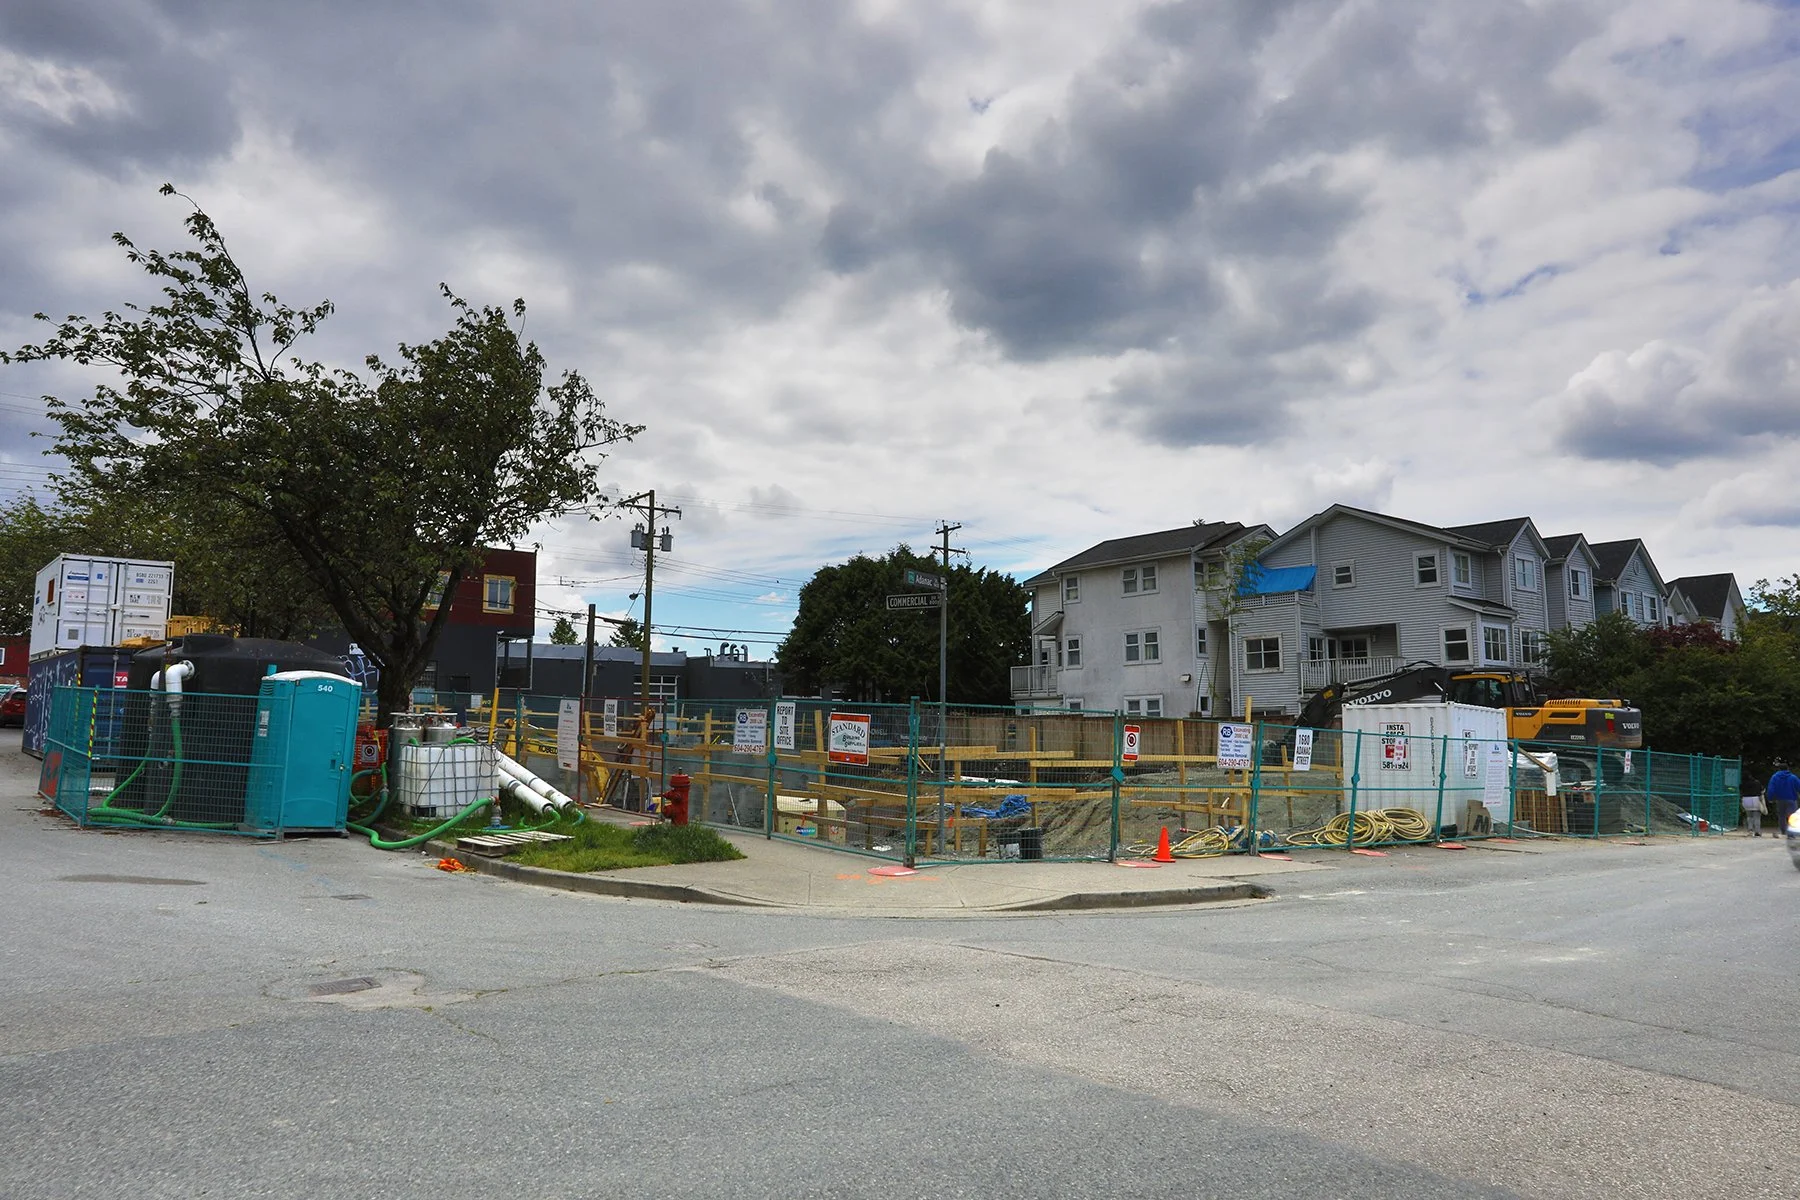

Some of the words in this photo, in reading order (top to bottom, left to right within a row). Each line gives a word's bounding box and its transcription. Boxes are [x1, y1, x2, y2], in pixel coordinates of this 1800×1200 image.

[890, 596, 928, 608] COMMERCIAL
[317, 684, 333, 692] 540
[1348, 689, 1392, 705] VOLVO
[776, 705, 794, 716] REPORT
[782, 716, 788, 725] TO
[780, 726, 789, 736] SITE
[832, 722, 866, 738] STANDARD
[1222, 728, 1231, 736] RB
[776, 736, 792, 746] OFFICE
[1298, 734, 1310, 745] 1680
[1296, 756, 1309, 765] STREET
